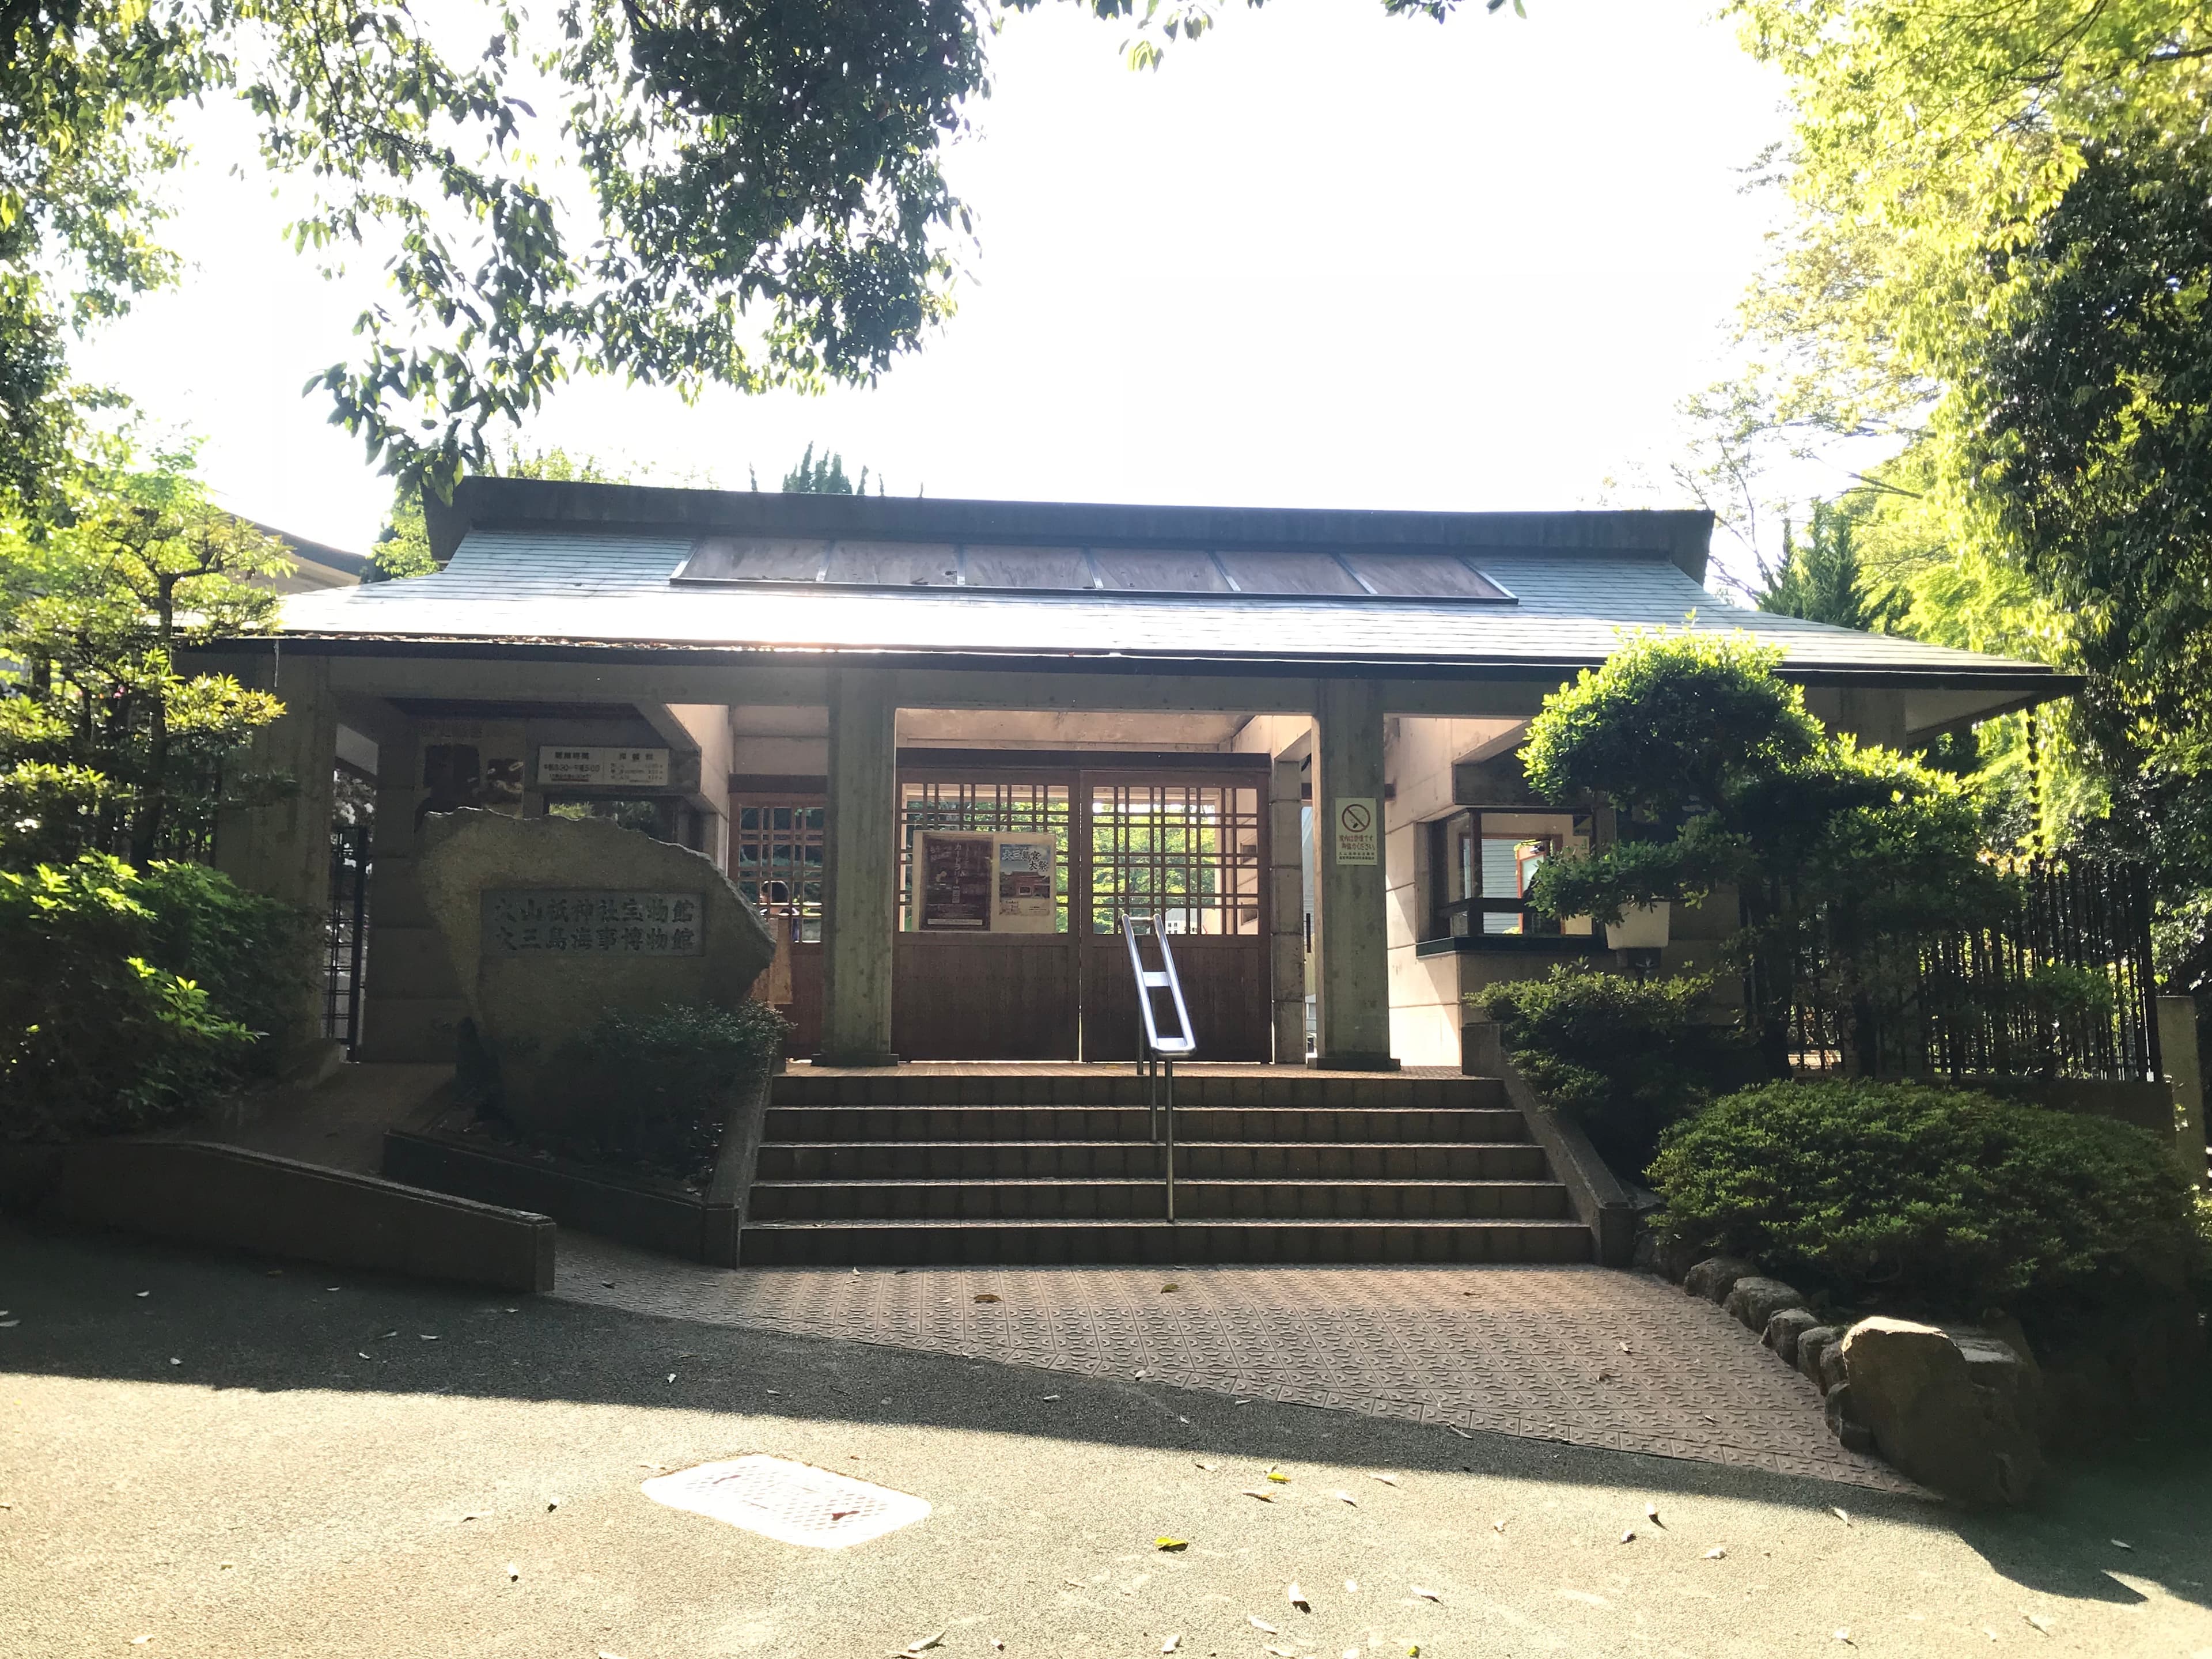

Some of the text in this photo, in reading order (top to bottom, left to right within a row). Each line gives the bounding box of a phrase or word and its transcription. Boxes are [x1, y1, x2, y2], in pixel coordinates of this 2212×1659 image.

[1029, 861, 1047, 870] 大祭
[495, 926, 695, 950] 大三島海事博物館
